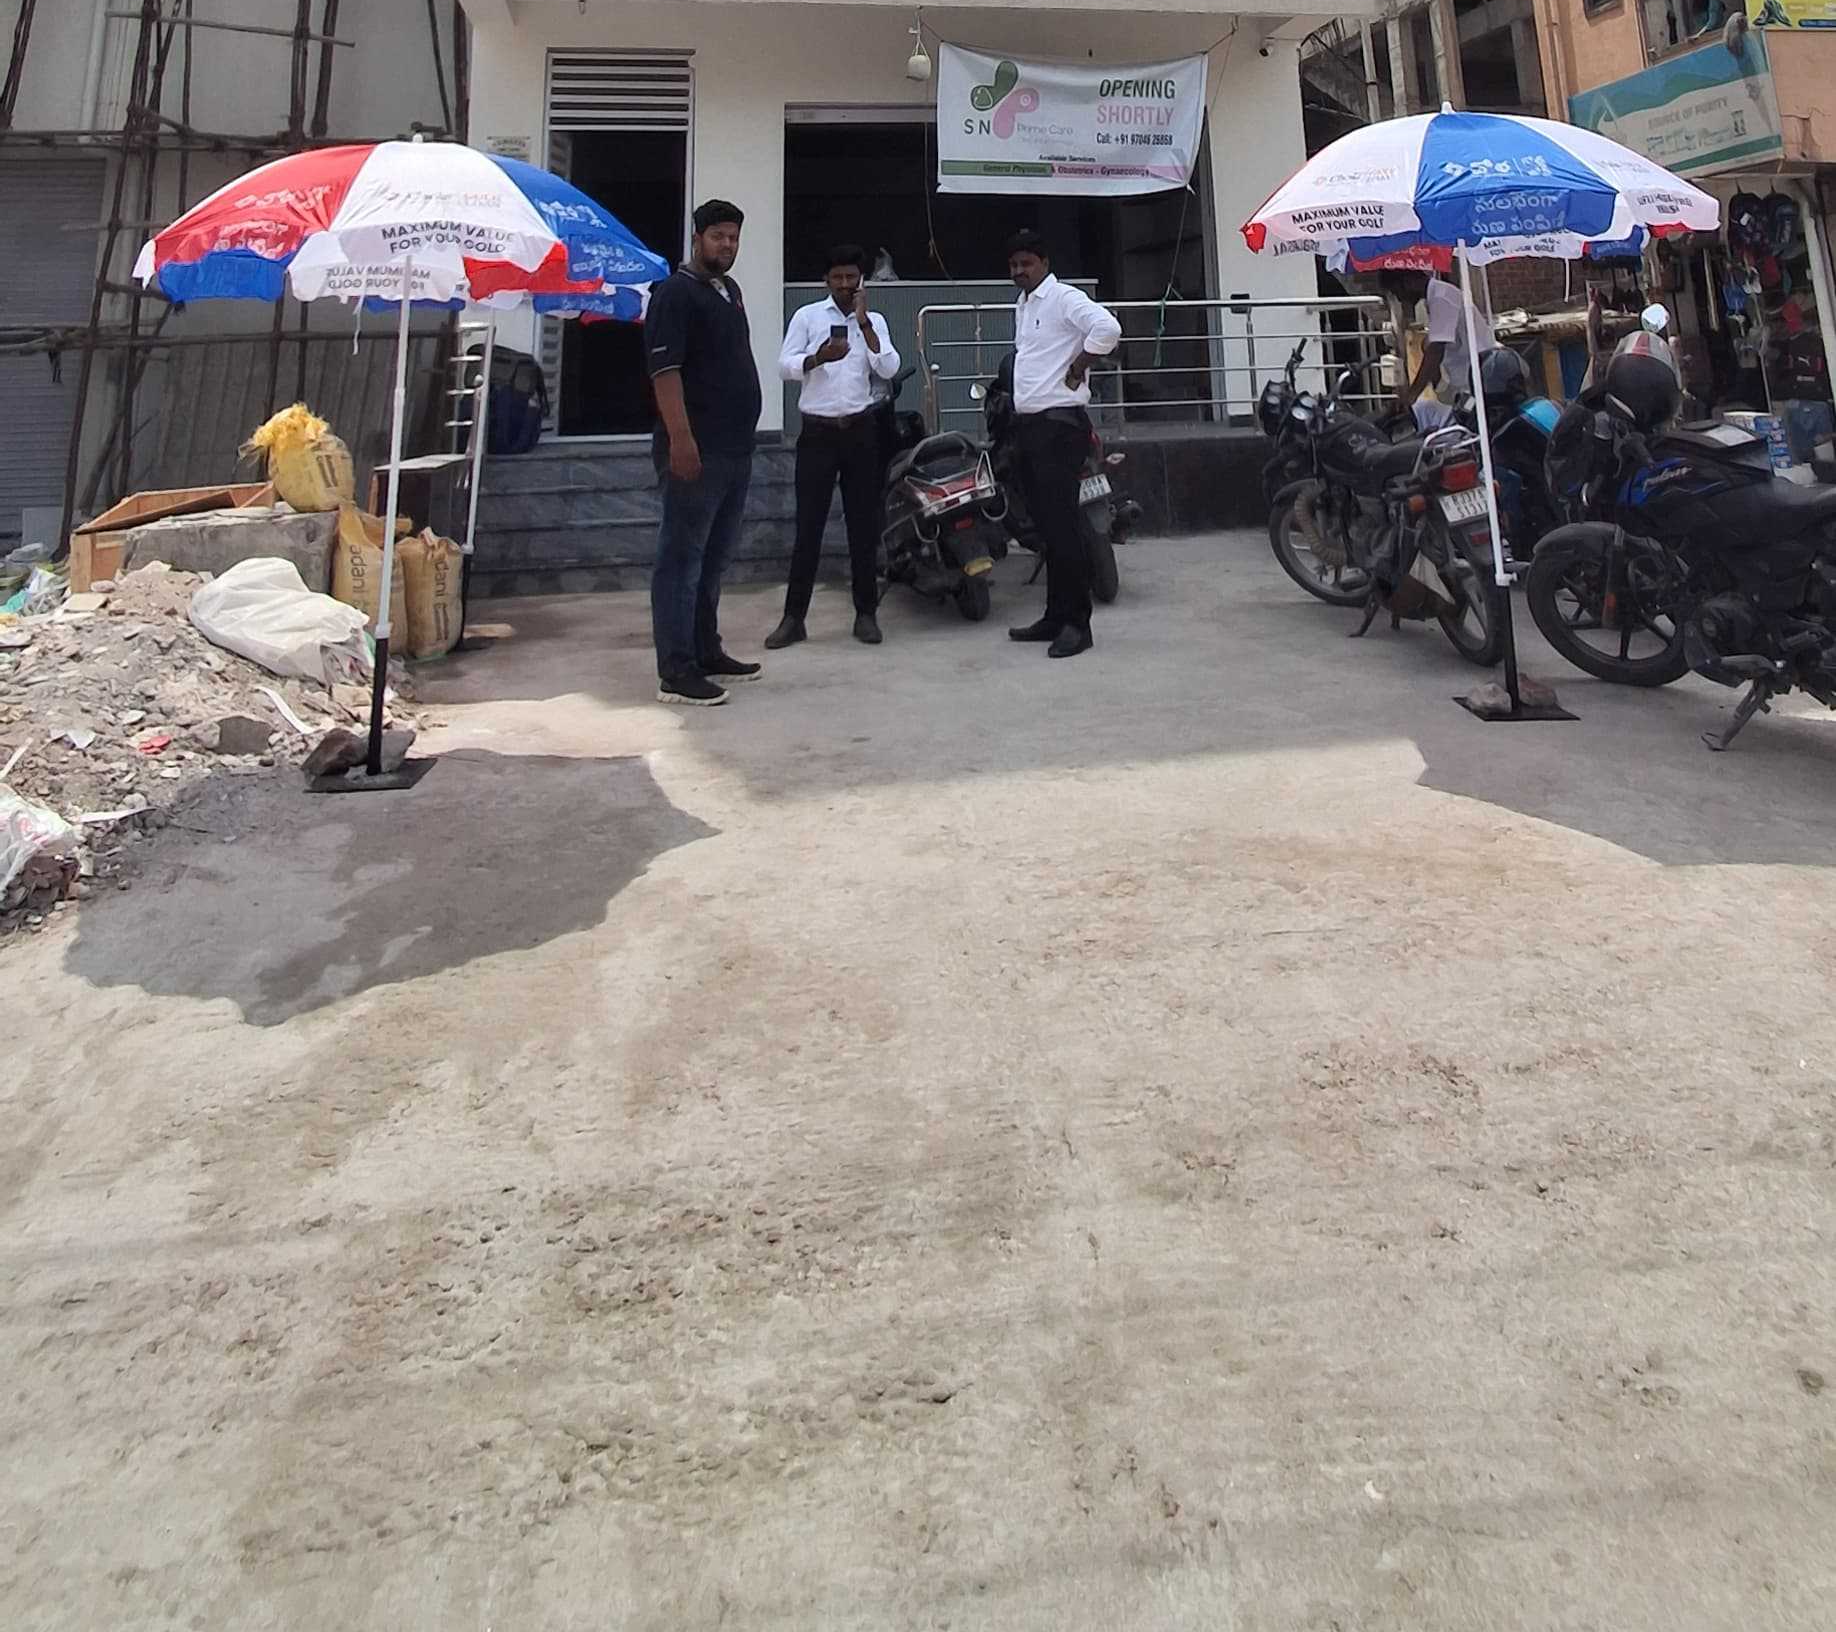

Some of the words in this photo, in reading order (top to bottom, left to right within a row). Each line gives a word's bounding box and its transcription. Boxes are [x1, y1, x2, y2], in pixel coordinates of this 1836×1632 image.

[1099, 79, 1175, 99] OPENING
[1097, 105, 1174, 126] SHORTLY
[1292, 206, 1350, 224] MAXIMUM
[382, 220, 462, 240] MAXIMUM
[1326, 220, 1356, 231] YOUR
[390, 236, 421, 253] FOR
[349, 544, 367, 594] adani
